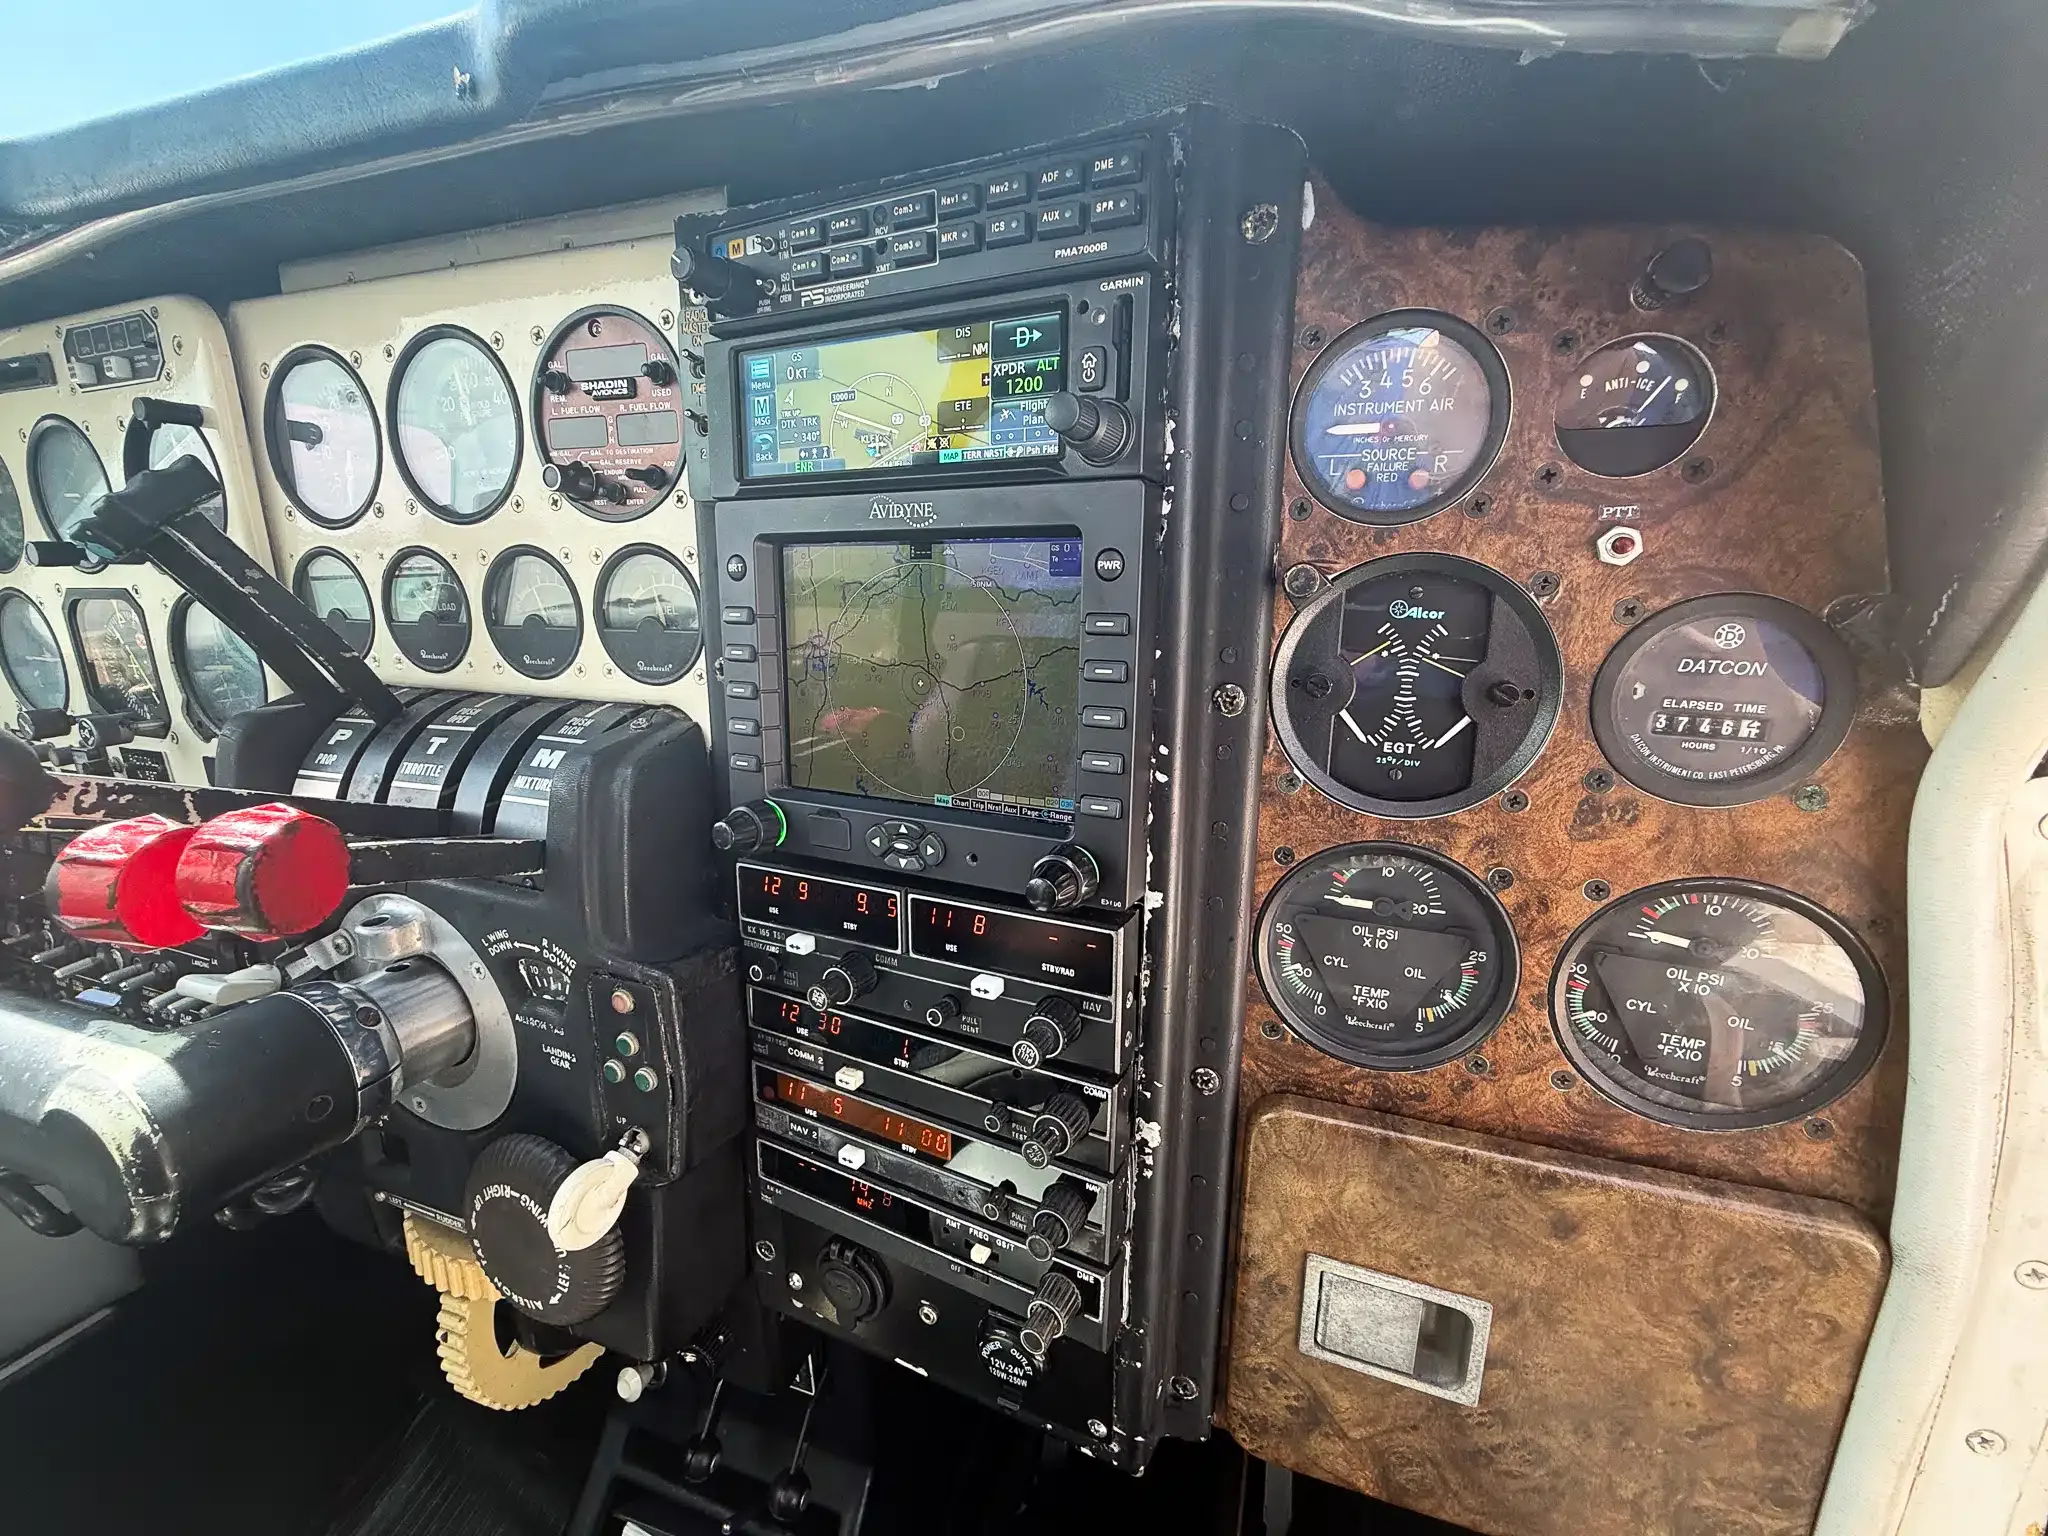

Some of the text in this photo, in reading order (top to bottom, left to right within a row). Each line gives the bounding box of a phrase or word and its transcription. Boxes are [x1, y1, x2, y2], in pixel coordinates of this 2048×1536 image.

[1041, 157, 1114, 183] ADF DME
[941, 181, 1010, 206] Nav1 Nav2
[791, 205, 914, 239] Com1 Com2 Com3
[941, 199, 1114, 243] MKR ICS AUX SPR
[874, 226, 889, 236] RCV
[732, 243, 741, 255] M
[792, 240, 914, 271] Com1 Com2 Com3
[1055, 241, 1108, 259] PMA7000B
[875, 263, 891, 272] XMT
[825, 281, 865, 295] ENGINEERING
[1100, 275, 1144, 292] GARMIN
[825, 290, 865, 304] INCORPORATED
[684, 308, 708, 322] RADIO
[955, 326, 971, 339] DIS
[972, 342, 989, 356] NM
[791, 351, 802, 362] GS
[993, 356, 1060, 377] XPDR ALT
[580, 379, 628, 391] SHADIN
[751, 381, 771, 391] Menu
[1006, 375, 1043, 395] 1200
[1359, 369, 1432, 399] 3 4 5 6
[1605, 378, 1655, 392] ANTI-ICE
[591, 388, 628, 397] AVIONICS
[651, 388, 672, 397] USED
[1580, 388, 1587, 399] E
[560, 405, 601, 415] FUEL FLOW
[629, 401, 672, 412] FUEL FLOW
[954, 400, 972, 411] ETE
[1020, 400, 1048, 412] Flight
[1333, 397, 1455, 416] INSTRUMENT AIR
[754, 416, 771, 426] MSG
[781, 417, 818, 429] DTK TRK
[1023, 414, 1044, 425] Plan
[1353, 434, 1429, 444] INCHES MERCURY
[615, 447, 654, 455] DESTINATION
[756, 452, 773, 462] Back
[943, 443, 1059, 462] MAP TERR NRST Psh Flds
[1361, 448, 1416, 462] SOURCE
[795, 461, 814, 473] ENR
[1330, 455, 1448, 483] L RED R
[1367, 461, 1409, 472] FAILURE
[626, 498, 645, 506] ENTER
[868, 501, 934, 521] AVIDYNE
[1601, 505, 1638, 519] PTT
[727, 563, 744, 573] BRT
[1097, 560, 1122, 570] PWR
[437, 602, 456, 611] LOAD
[1405, 606, 1445, 620] Alcor
[1677, 658, 1768, 677] DATCON
[1663, 698, 1767, 714] ELAPSED TIME
[566, 716, 595, 727] PUSH
[327, 728, 354, 745] P
[557, 725, 584, 736] RICH
[425, 736, 448, 755] T
[1383, 741, 1416, 755] EGT
[1681, 741, 1716, 751] HOURS
[1740, 746, 1767, 755] 1/10
[314, 752, 337, 765] PROP
[529, 747, 567, 770] M
[1630, 733, 1728, 780] DATCON INSTRUMENT EAST
[400, 761, 445, 778] THROTTLE
[953, 798, 1073, 822] Chart Trip Nrst Aux Page Range
[1381, 867, 1396, 878] 10
[768, 906, 779, 915] USE
[1705, 903, 1722, 916] 10
[843, 921, 858, 931] STBY
[1275, 922, 1292, 934] 50
[1352, 925, 1399, 940] OIL PSI
[487, 928, 510, 945] WING
[488, 940, 513, 957] DOWN
[945, 943, 958, 953] USE
[1363, 937, 1389, 950] X 10
[542, 937, 577, 970] R WING
[875, 953, 898, 966] COMM
[1469, 950, 1487, 963] 25
[542, 949, 574, 977] DOWN
[1323, 954, 1427, 980] CYL OIL
[1041, 963, 1075, 977] STBY/RAD
[1665, 967, 1725, 988] OIL PSI
[1353, 985, 1390, 999] TEMP
[1677, 981, 1711, 996] X 10
[1082, 1001, 1102, 1012] NAV
[1314, 1006, 1327, 1016] 10
[1625, 998, 1657, 1015] CYL
[962, 1015, 979, 1025] PULL
[1727, 1000, 1834, 1031] OIL 25
[796, 1026, 809, 1037] USE
[960, 1024, 980, 1034] IDENT
[1415, 1022, 1424, 1033] 5
[1660, 1032, 1707, 1050] TEMP
[787, 1047, 824, 1065] COMM 2
[550, 1055, 572, 1071] GEAR
[893, 1057, 910, 1069] STBY
[1730, 1075, 1743, 1087] 5
[1083, 1086, 1107, 1099] COMM
[804, 1107, 817, 1118] USE
[616, 1115, 627, 1125] UP
[790, 1122, 809, 1138] NAV
[811, 1131, 818, 1140] 2
[1011, 1122, 1028, 1133] PULL
[1011, 1131, 1028, 1141] TEST
[901, 1143, 917, 1154] STBY
[1085, 1182, 1101, 1193] NAV
[945, 1218, 1015, 1252] RMT FREQ GS/T
[1076, 1270, 1095, 1284] DME
[981, 1340, 1033, 1376] POWER OUTLET
[989, 1356, 1025, 1377] 12V-24V
